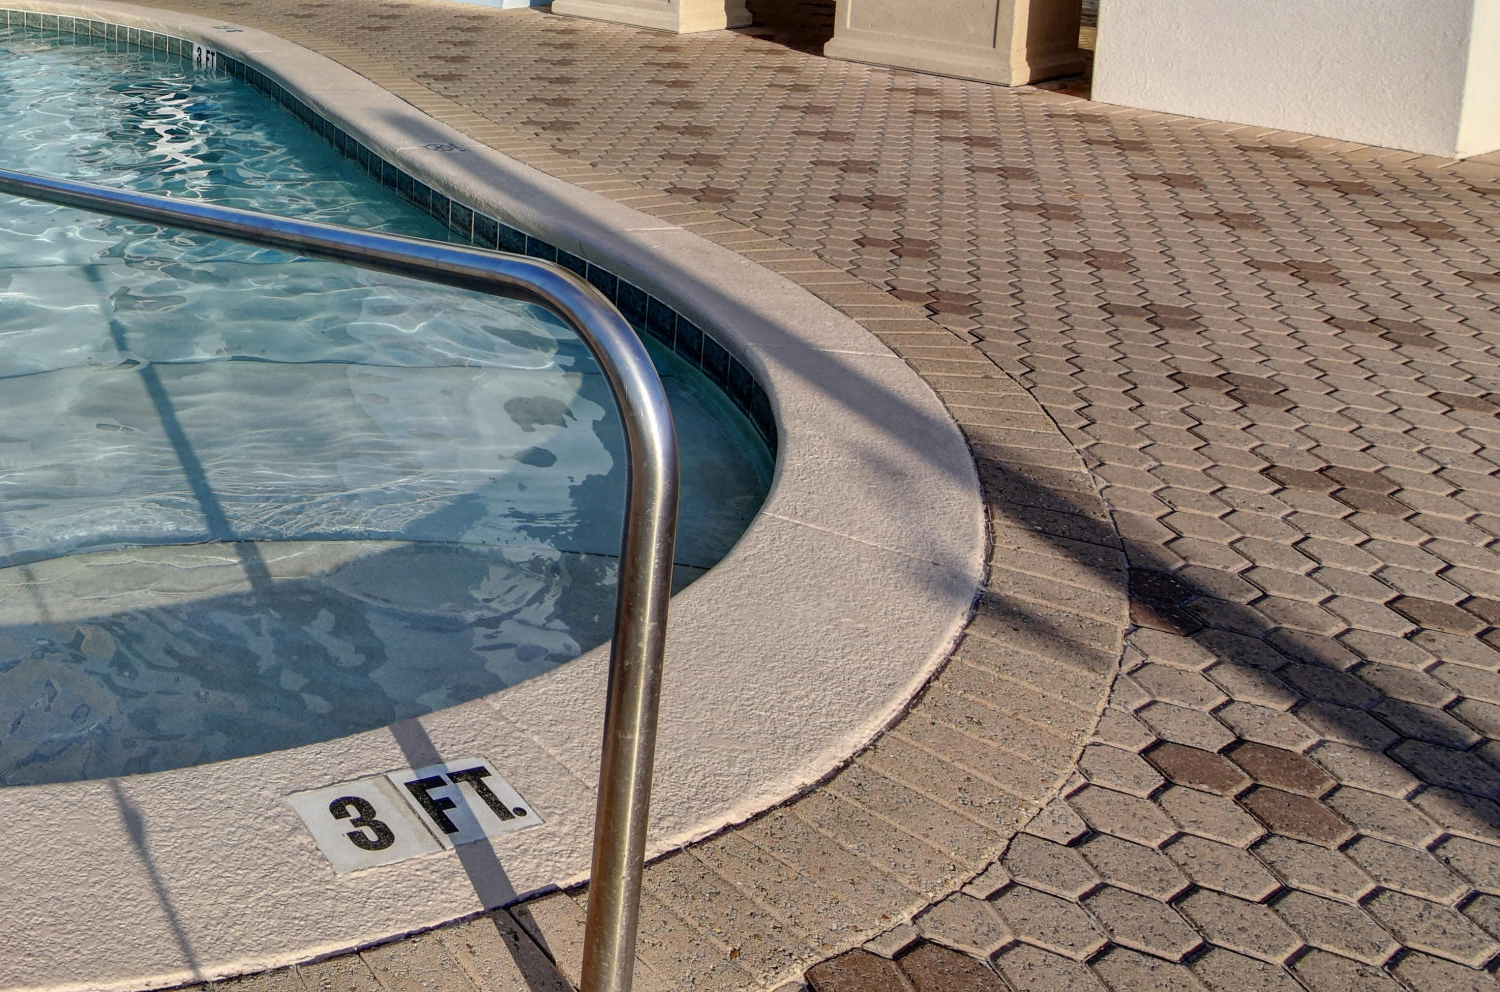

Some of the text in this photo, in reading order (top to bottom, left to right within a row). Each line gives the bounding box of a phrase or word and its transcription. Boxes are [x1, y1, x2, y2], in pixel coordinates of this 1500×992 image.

[205, 49, 216, 68] FT
[328, 765, 528, 851] 3 FT.
